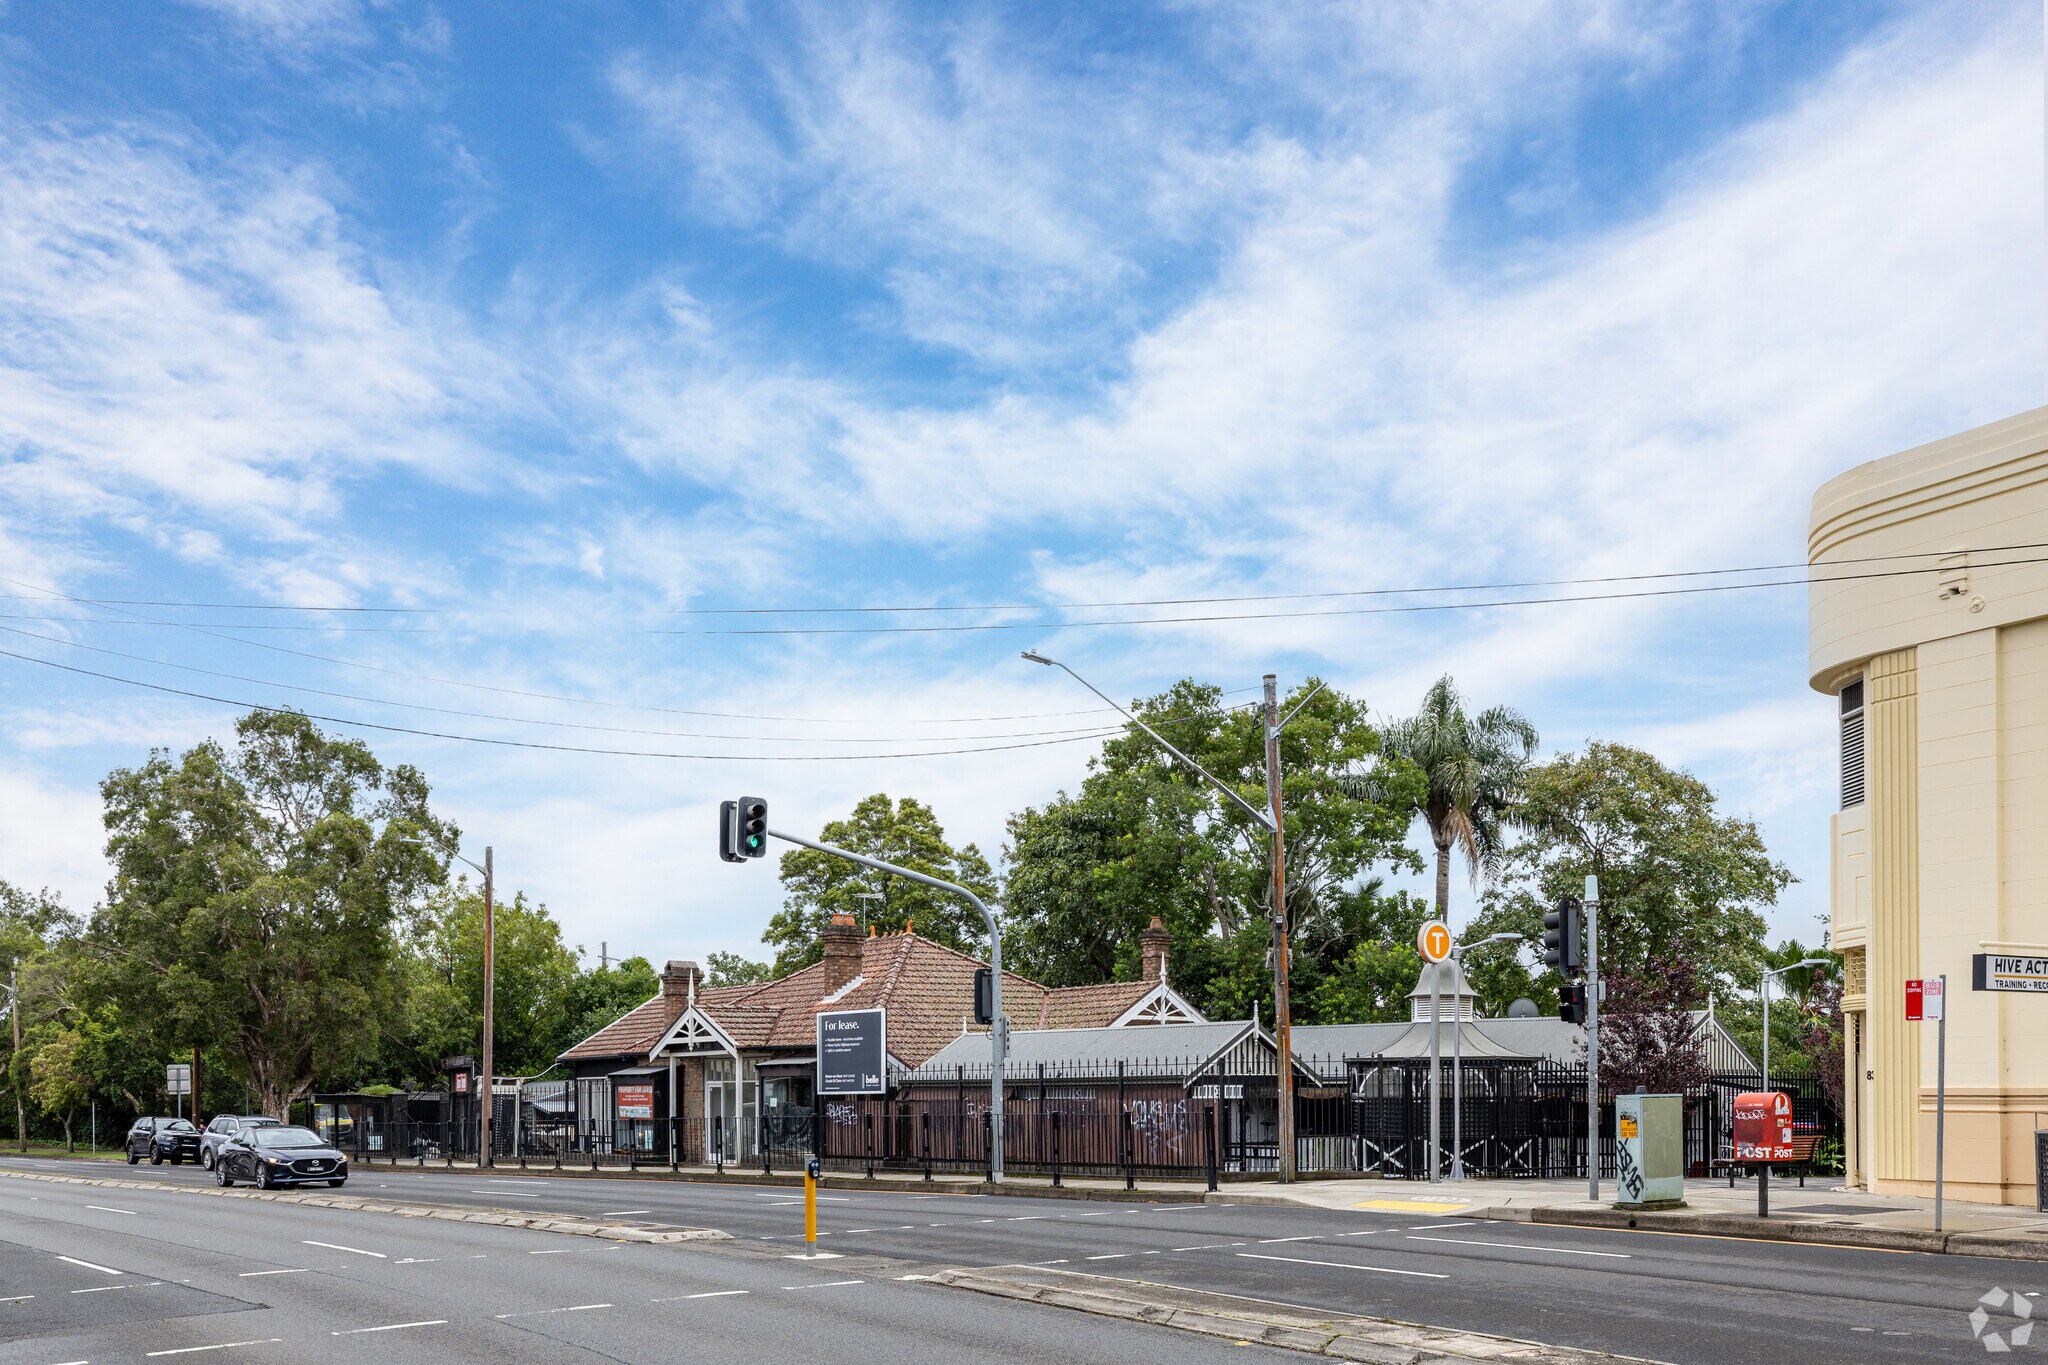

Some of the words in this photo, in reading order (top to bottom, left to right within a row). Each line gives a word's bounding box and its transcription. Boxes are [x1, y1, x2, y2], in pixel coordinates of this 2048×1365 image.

[1431, 932, 1444, 954] T
[1995, 958, 2022, 973] HIVE
[2025, 960, 2048, 974] ACT
[1995, 980, 2027, 989] TRAINING
[825, 1021, 837, 1030] For
[838, 1020, 859, 1030] lease.
[866, 1075, 879, 1083] belle
[1737, 1146, 1772, 1159] POST
[1774, 1148, 1793, 1158] POST
